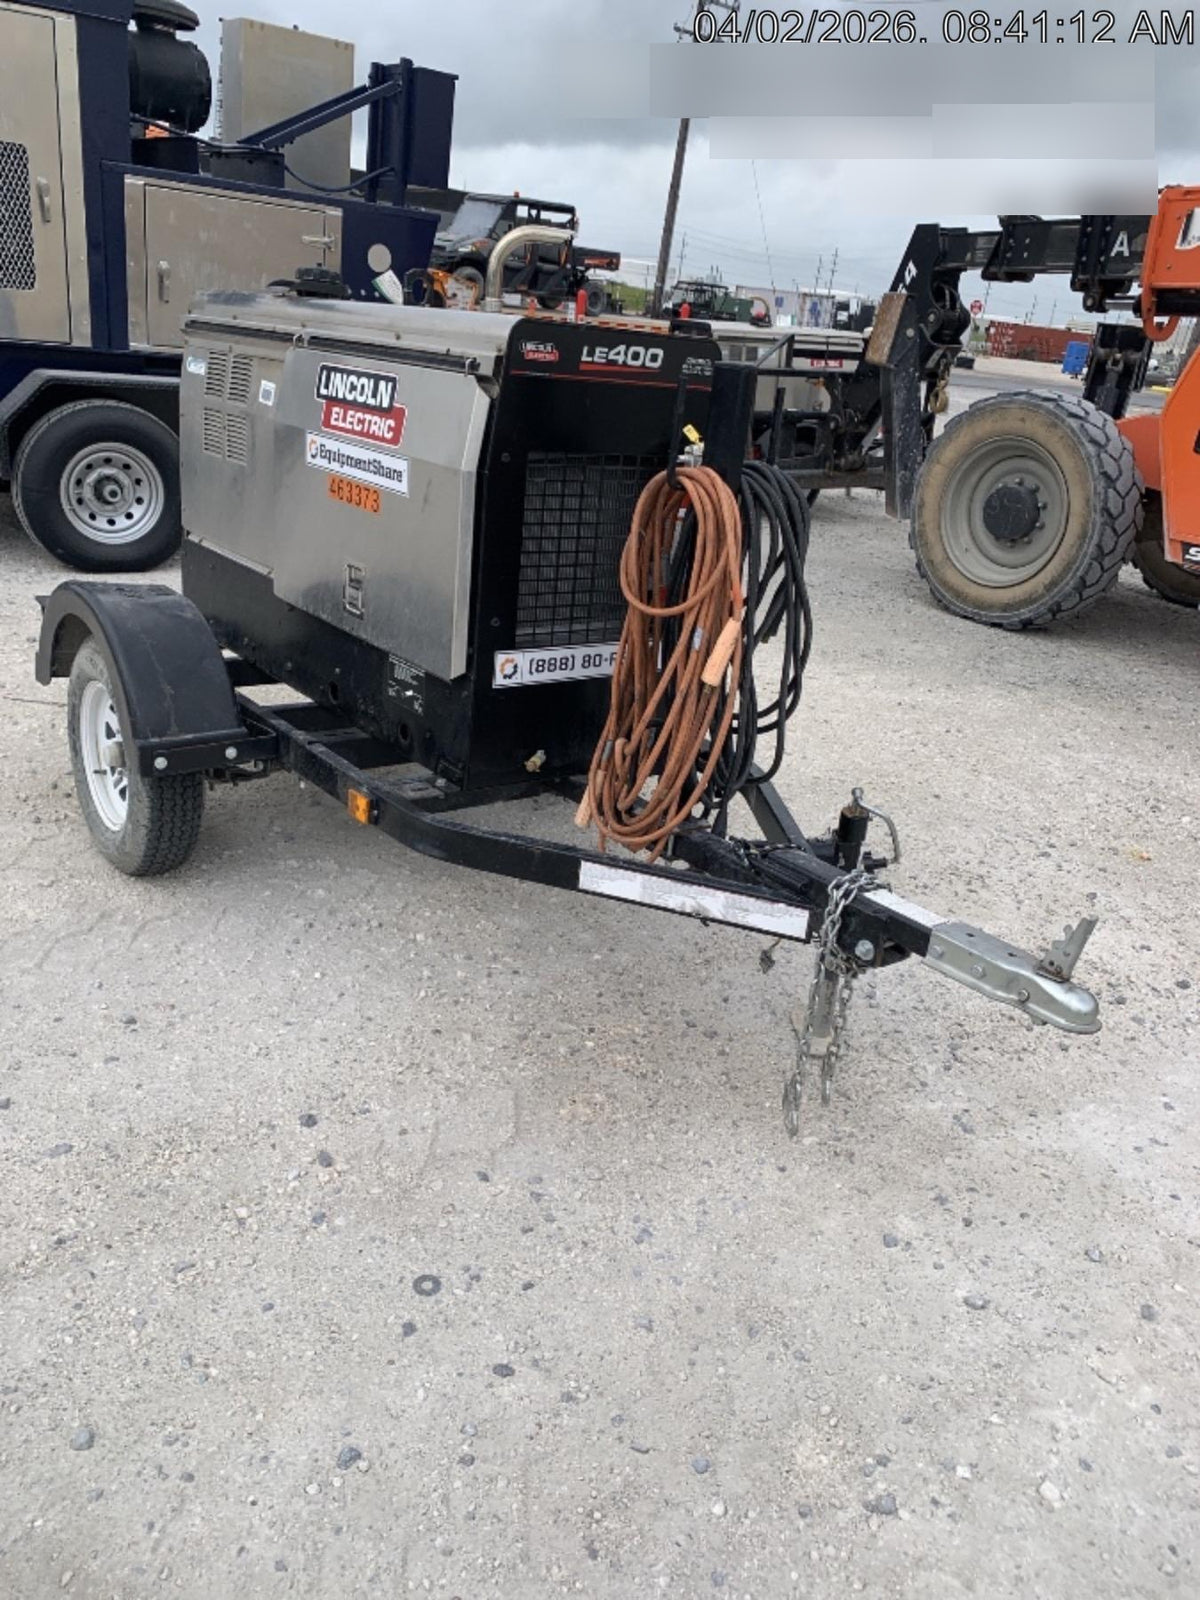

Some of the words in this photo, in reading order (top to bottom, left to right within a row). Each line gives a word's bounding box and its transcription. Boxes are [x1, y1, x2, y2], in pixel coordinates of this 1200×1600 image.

[1110, 231, 1130, 257] A
[580, 344, 665, 369] LE400
[319, 369, 393, 408] LINCOLN
[329, 407, 397, 440] ELECTRIC
[319, 443, 405, 484] EquipmentShare
[328, 477, 380, 513] 463373
[528, 654, 576, 676] (888)
